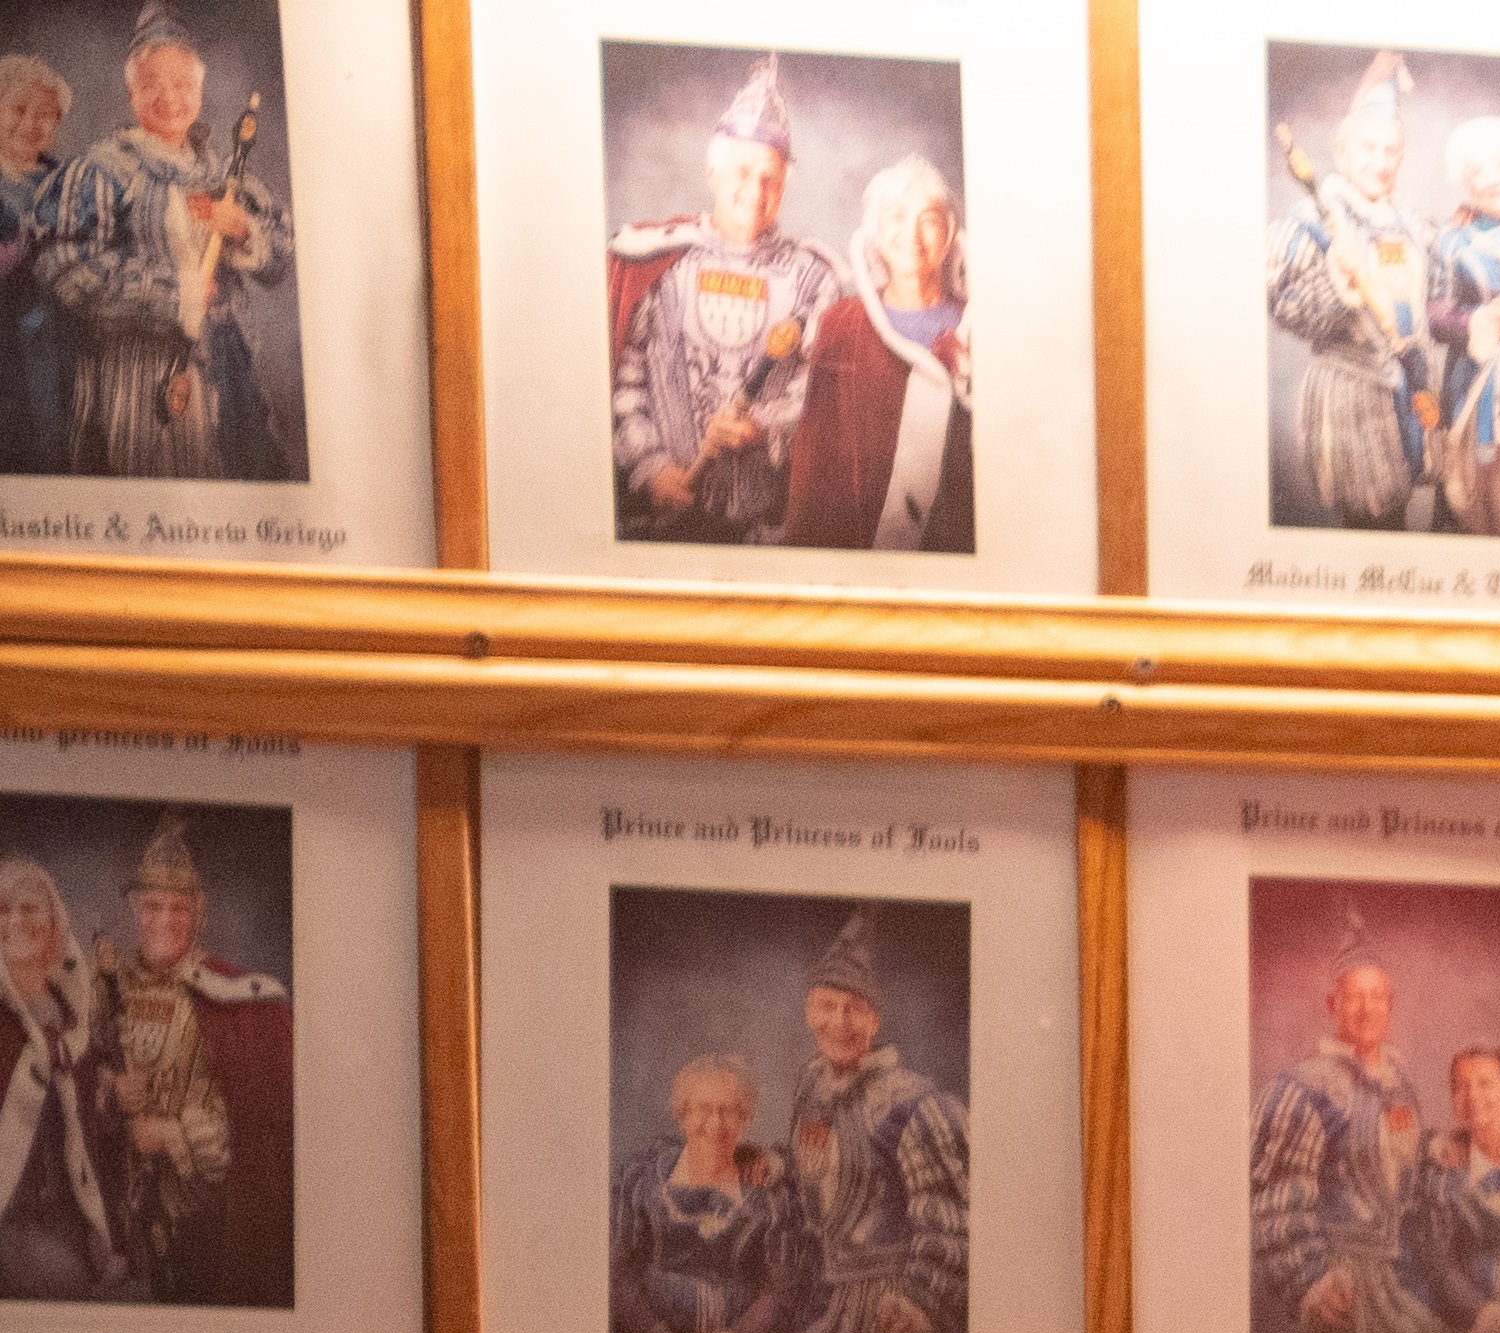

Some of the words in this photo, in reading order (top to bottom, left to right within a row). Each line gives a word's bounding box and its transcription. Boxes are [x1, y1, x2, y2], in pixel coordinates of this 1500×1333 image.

[103, 513, 130, 543] &
[140, 513, 248, 548] Andrew
[1451, 569, 1476, 600] &
[602, 807, 685, 842] Prince
[693, 822, 740, 843] and
[750, 815, 862, 852] Princess
[871, 824, 895, 849] of
[904, 826, 979, 854] Fools
